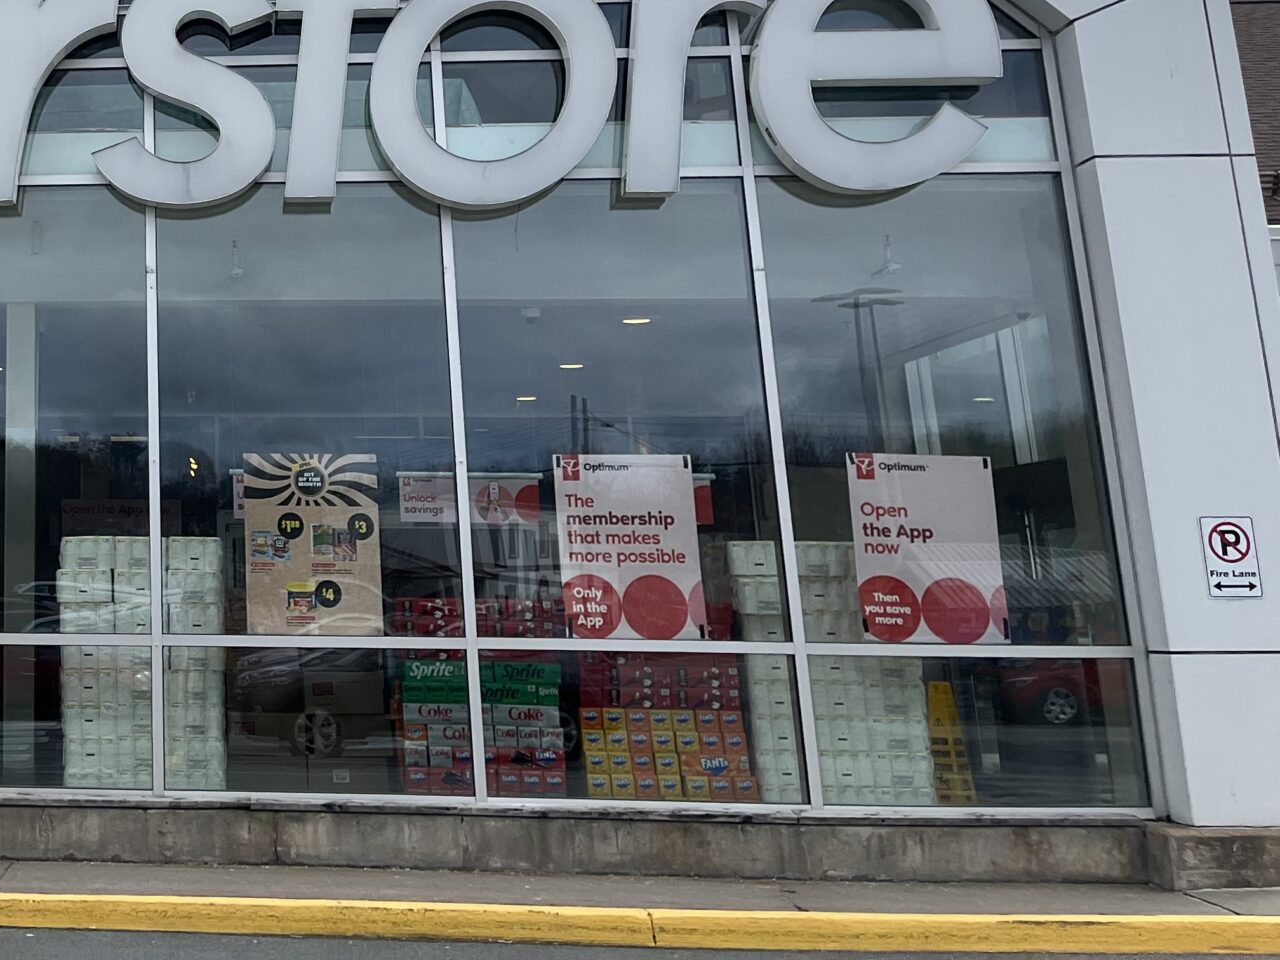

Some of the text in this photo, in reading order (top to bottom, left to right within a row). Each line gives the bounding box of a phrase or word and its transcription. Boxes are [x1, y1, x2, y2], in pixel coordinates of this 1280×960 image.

[584, 463, 629, 473] Optimum
[879, 462, 926, 473] Optimum
[403, 493, 437, 503] Unlock
[565, 494, 594, 508] The
[404, 504, 445, 517] savings
[860, 502, 908, 521] Open
[567, 511, 675, 530] membership
[355, 521, 367, 534] $3
[862, 523, 934, 543] the App
[568, 530, 661, 545] that makes
[864, 543, 901, 554] now
[569, 549, 686, 567] more possible
[1210, 570, 1257, 578] Fire Lane
[322, 588, 335, 601] $4
[574, 587, 603, 602] Only
[873, 592, 900, 603] Then
[573, 602, 608, 613] in the
[864, 604, 912, 616] you save
[577, 615, 604, 629] App
[875, 616, 904, 626] more
[409, 662, 454, 680] Sprite
[418, 704, 454, 719] Coke
[508, 706, 544, 721] Coke
[443, 725, 470, 740] Cok
[701, 757, 729, 770] FANTA
